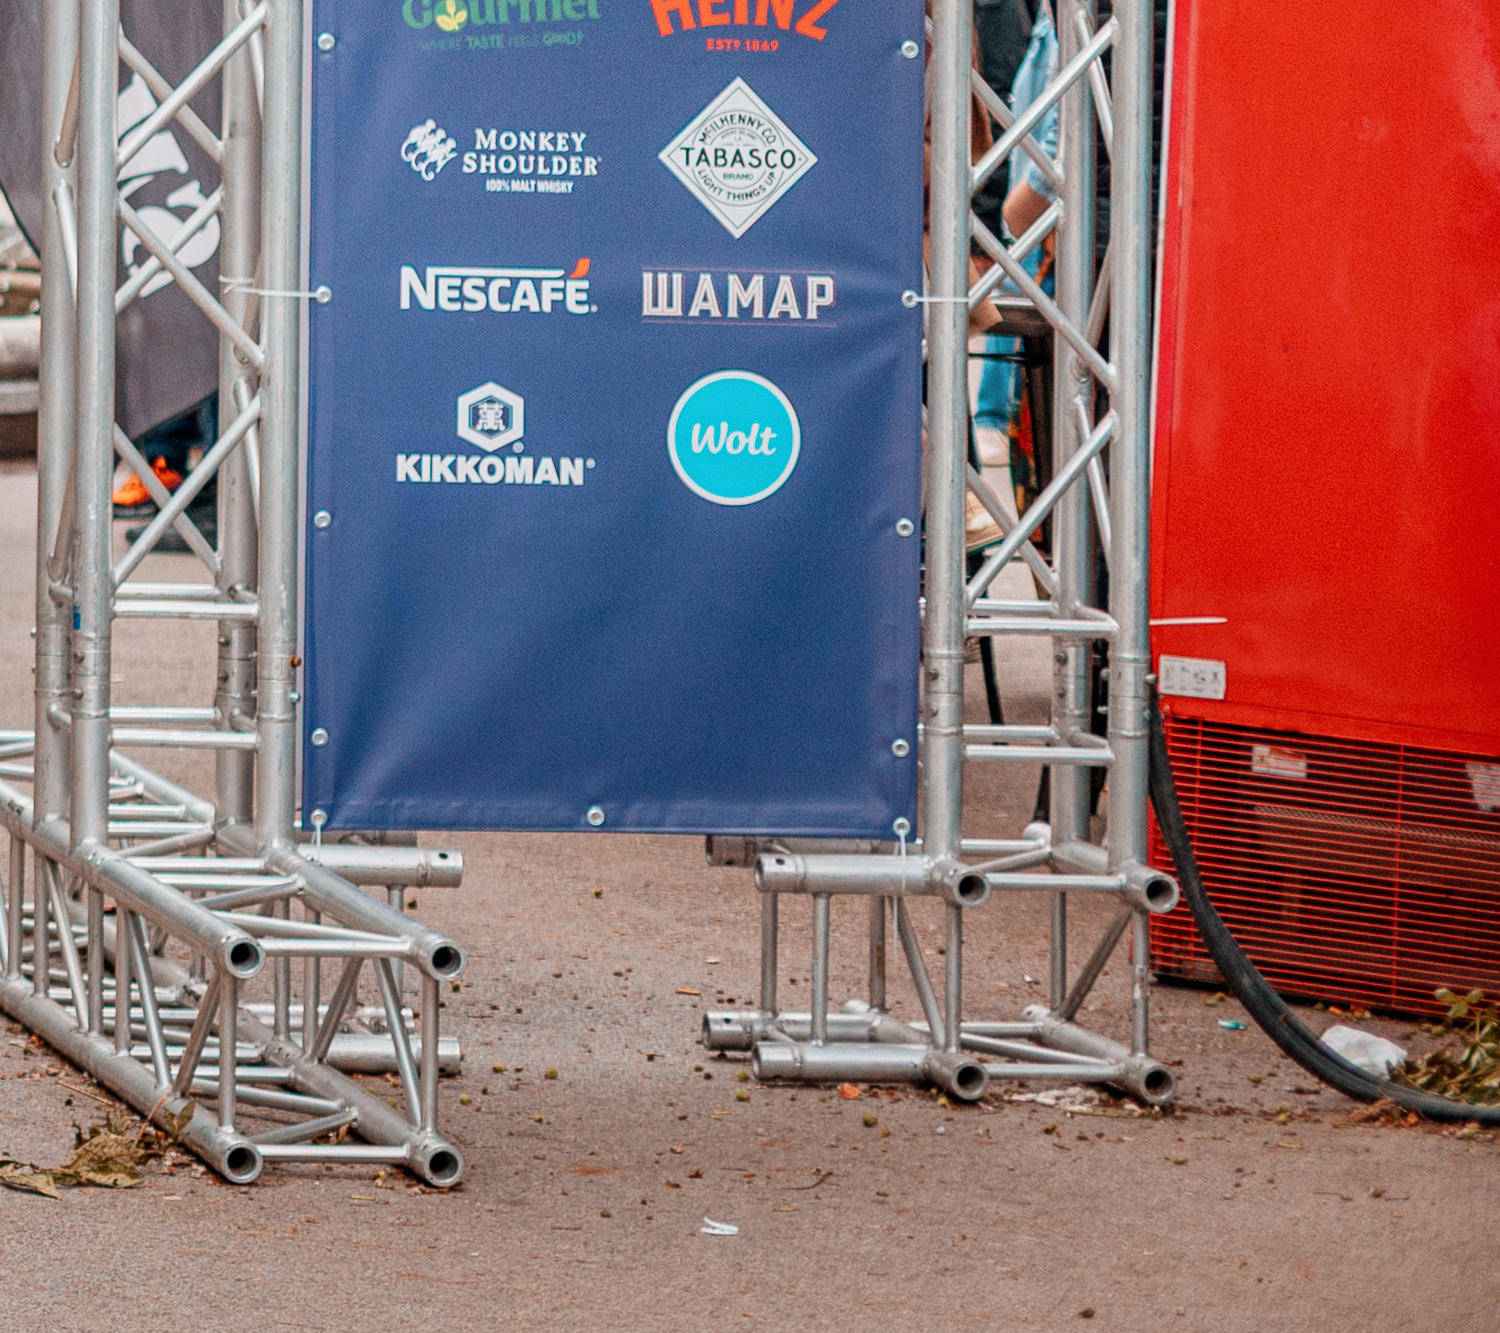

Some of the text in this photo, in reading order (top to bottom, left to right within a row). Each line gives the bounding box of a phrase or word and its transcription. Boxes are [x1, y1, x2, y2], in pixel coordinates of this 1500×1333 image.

[465, 32, 504, 49] TASTE
[745, 38, 780, 52] 1869
[474, 127, 588, 153] MONKEY
[462, 151, 599, 177] SHOULDER
[681, 146, 797, 170] TABASCO
[485, 178, 574, 195] 100% MALT WHISKY
[698, 167, 778, 203] LIGHT THINGS UP
[723, 171, 754, 183] BRAND
[401, 258, 591, 314] NESCAFÉ
[642, 271, 837, 321] ШАМАР
[691, 421, 778, 457] Wolt
[396, 454, 585, 486] KIKKOMAN
